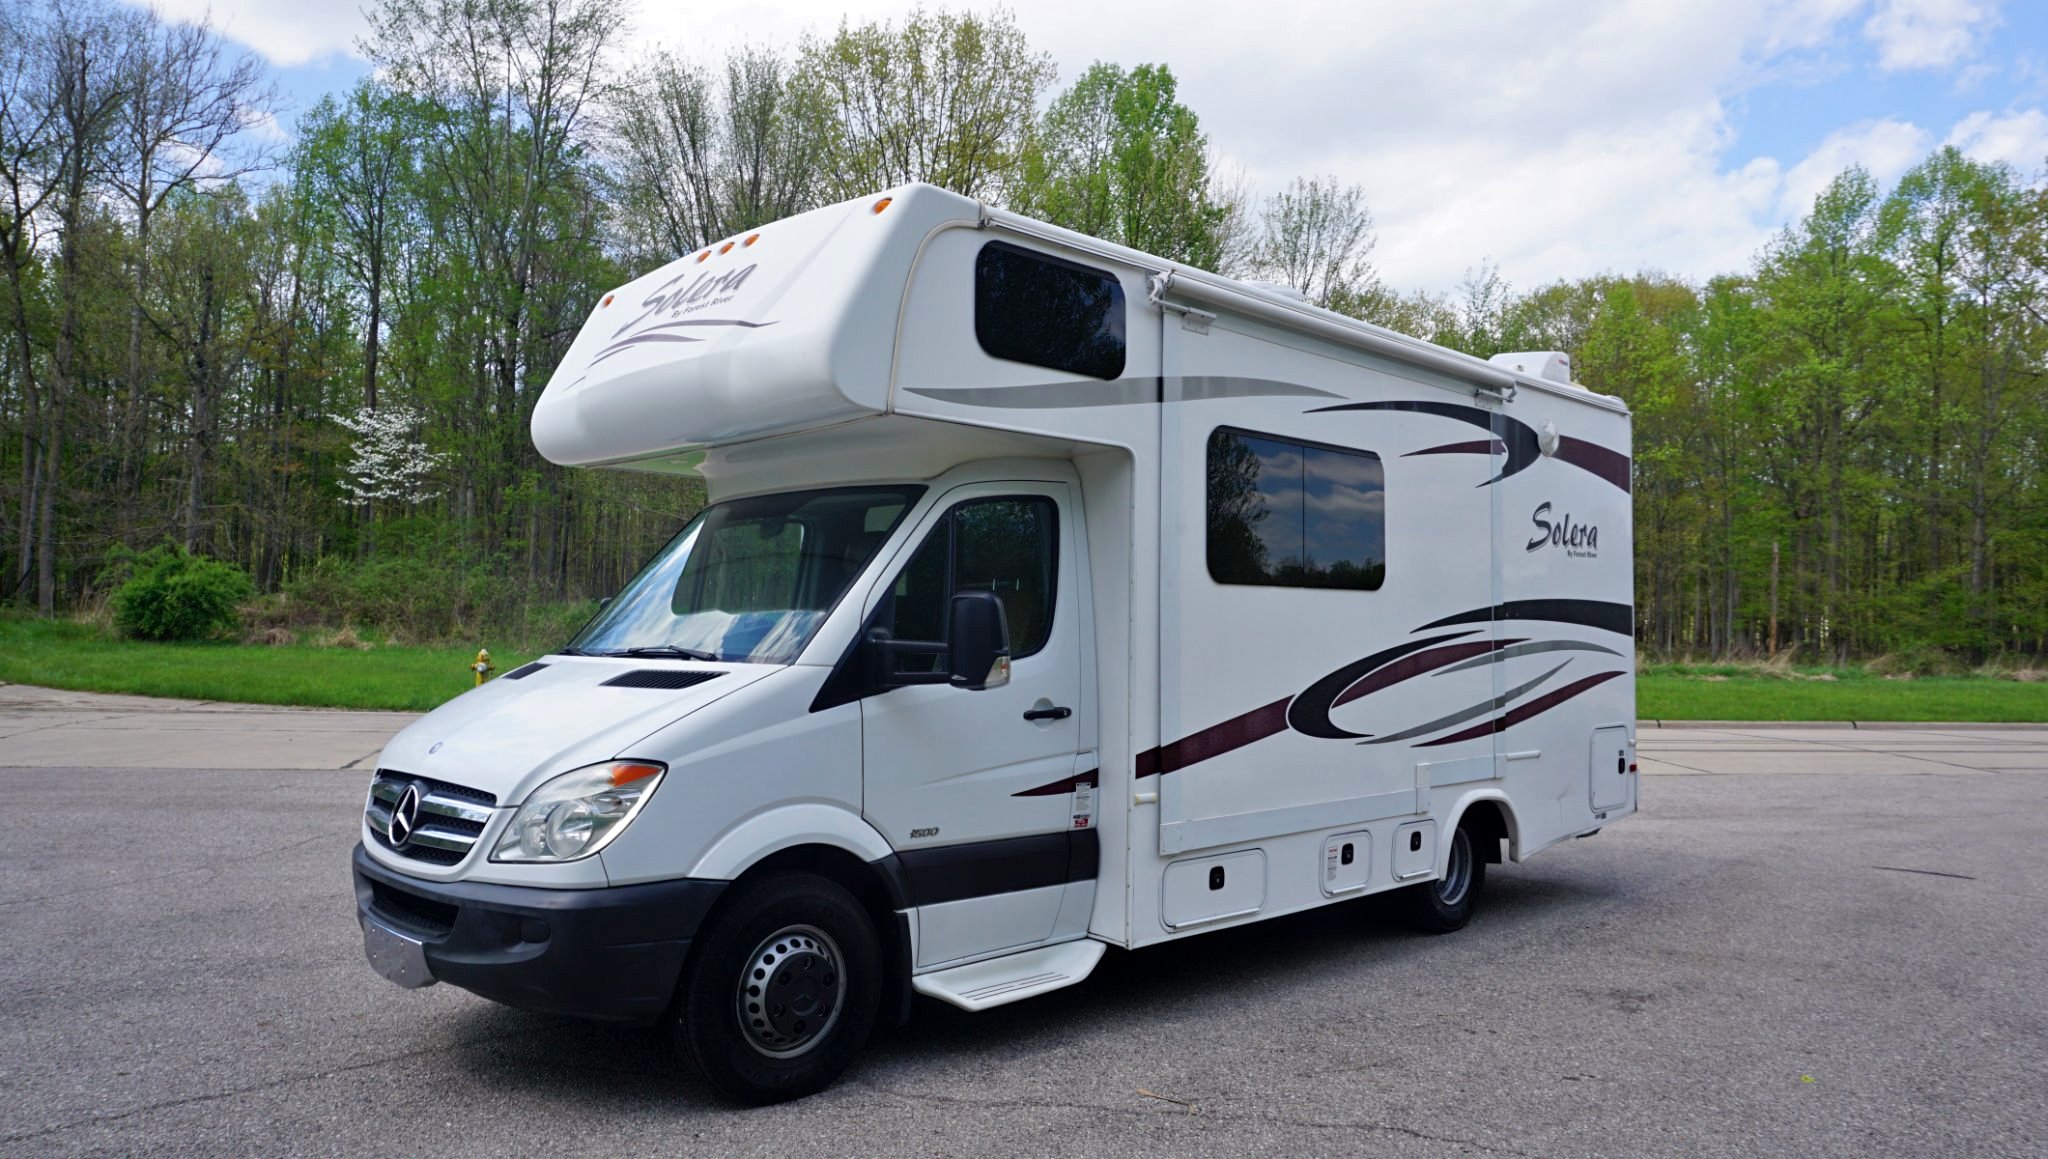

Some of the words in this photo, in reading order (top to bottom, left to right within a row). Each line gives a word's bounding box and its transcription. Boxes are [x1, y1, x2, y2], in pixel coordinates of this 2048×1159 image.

[611, 263, 758, 339] Solera
[671, 309, 683, 319] By
[683, 301, 710, 315] Forest
[710, 295, 734, 306] River
[1526, 501, 1598, 553] Solera
